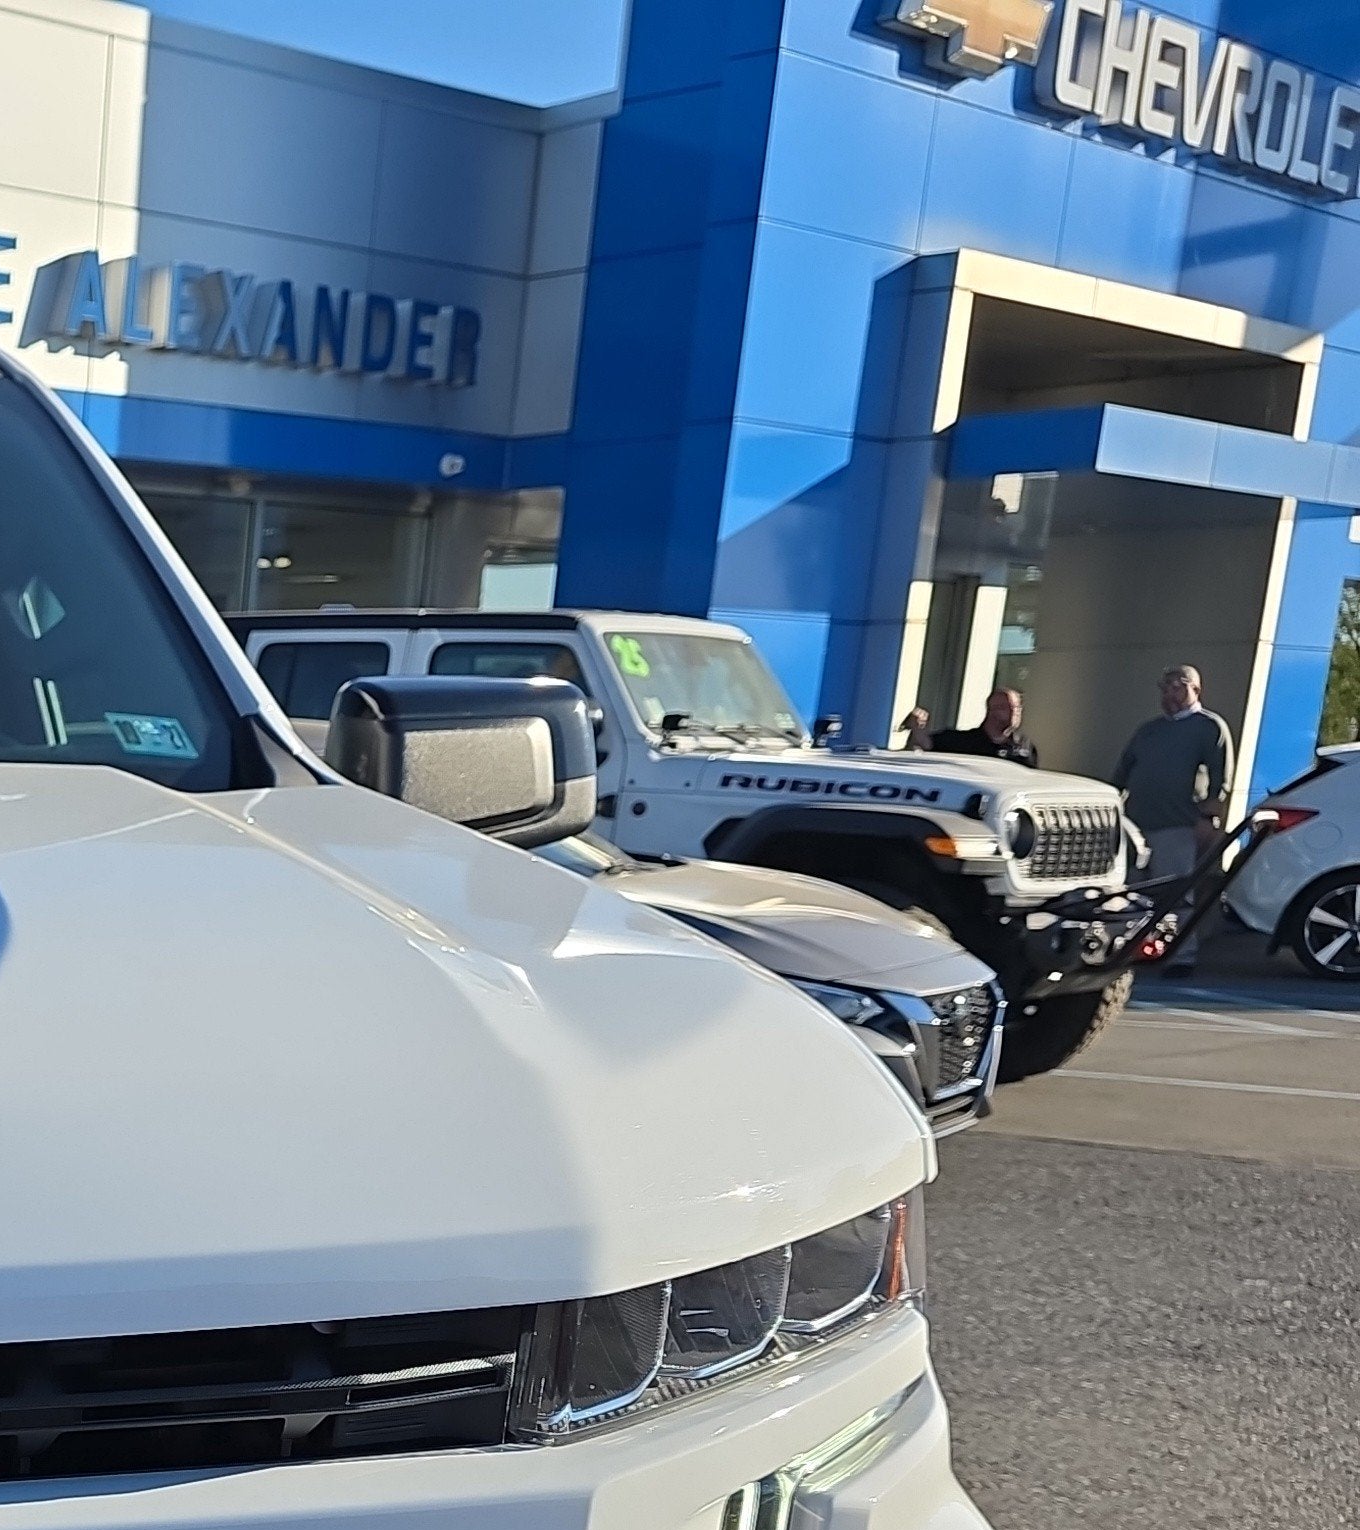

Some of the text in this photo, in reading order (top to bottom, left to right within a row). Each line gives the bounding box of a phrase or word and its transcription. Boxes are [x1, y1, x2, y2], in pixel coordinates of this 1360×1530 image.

[1055, 0, 1360, 197] CHEVROLE
[65, 249, 481, 388] ALEXANDER
[721, 773, 941, 802] RUBICON
